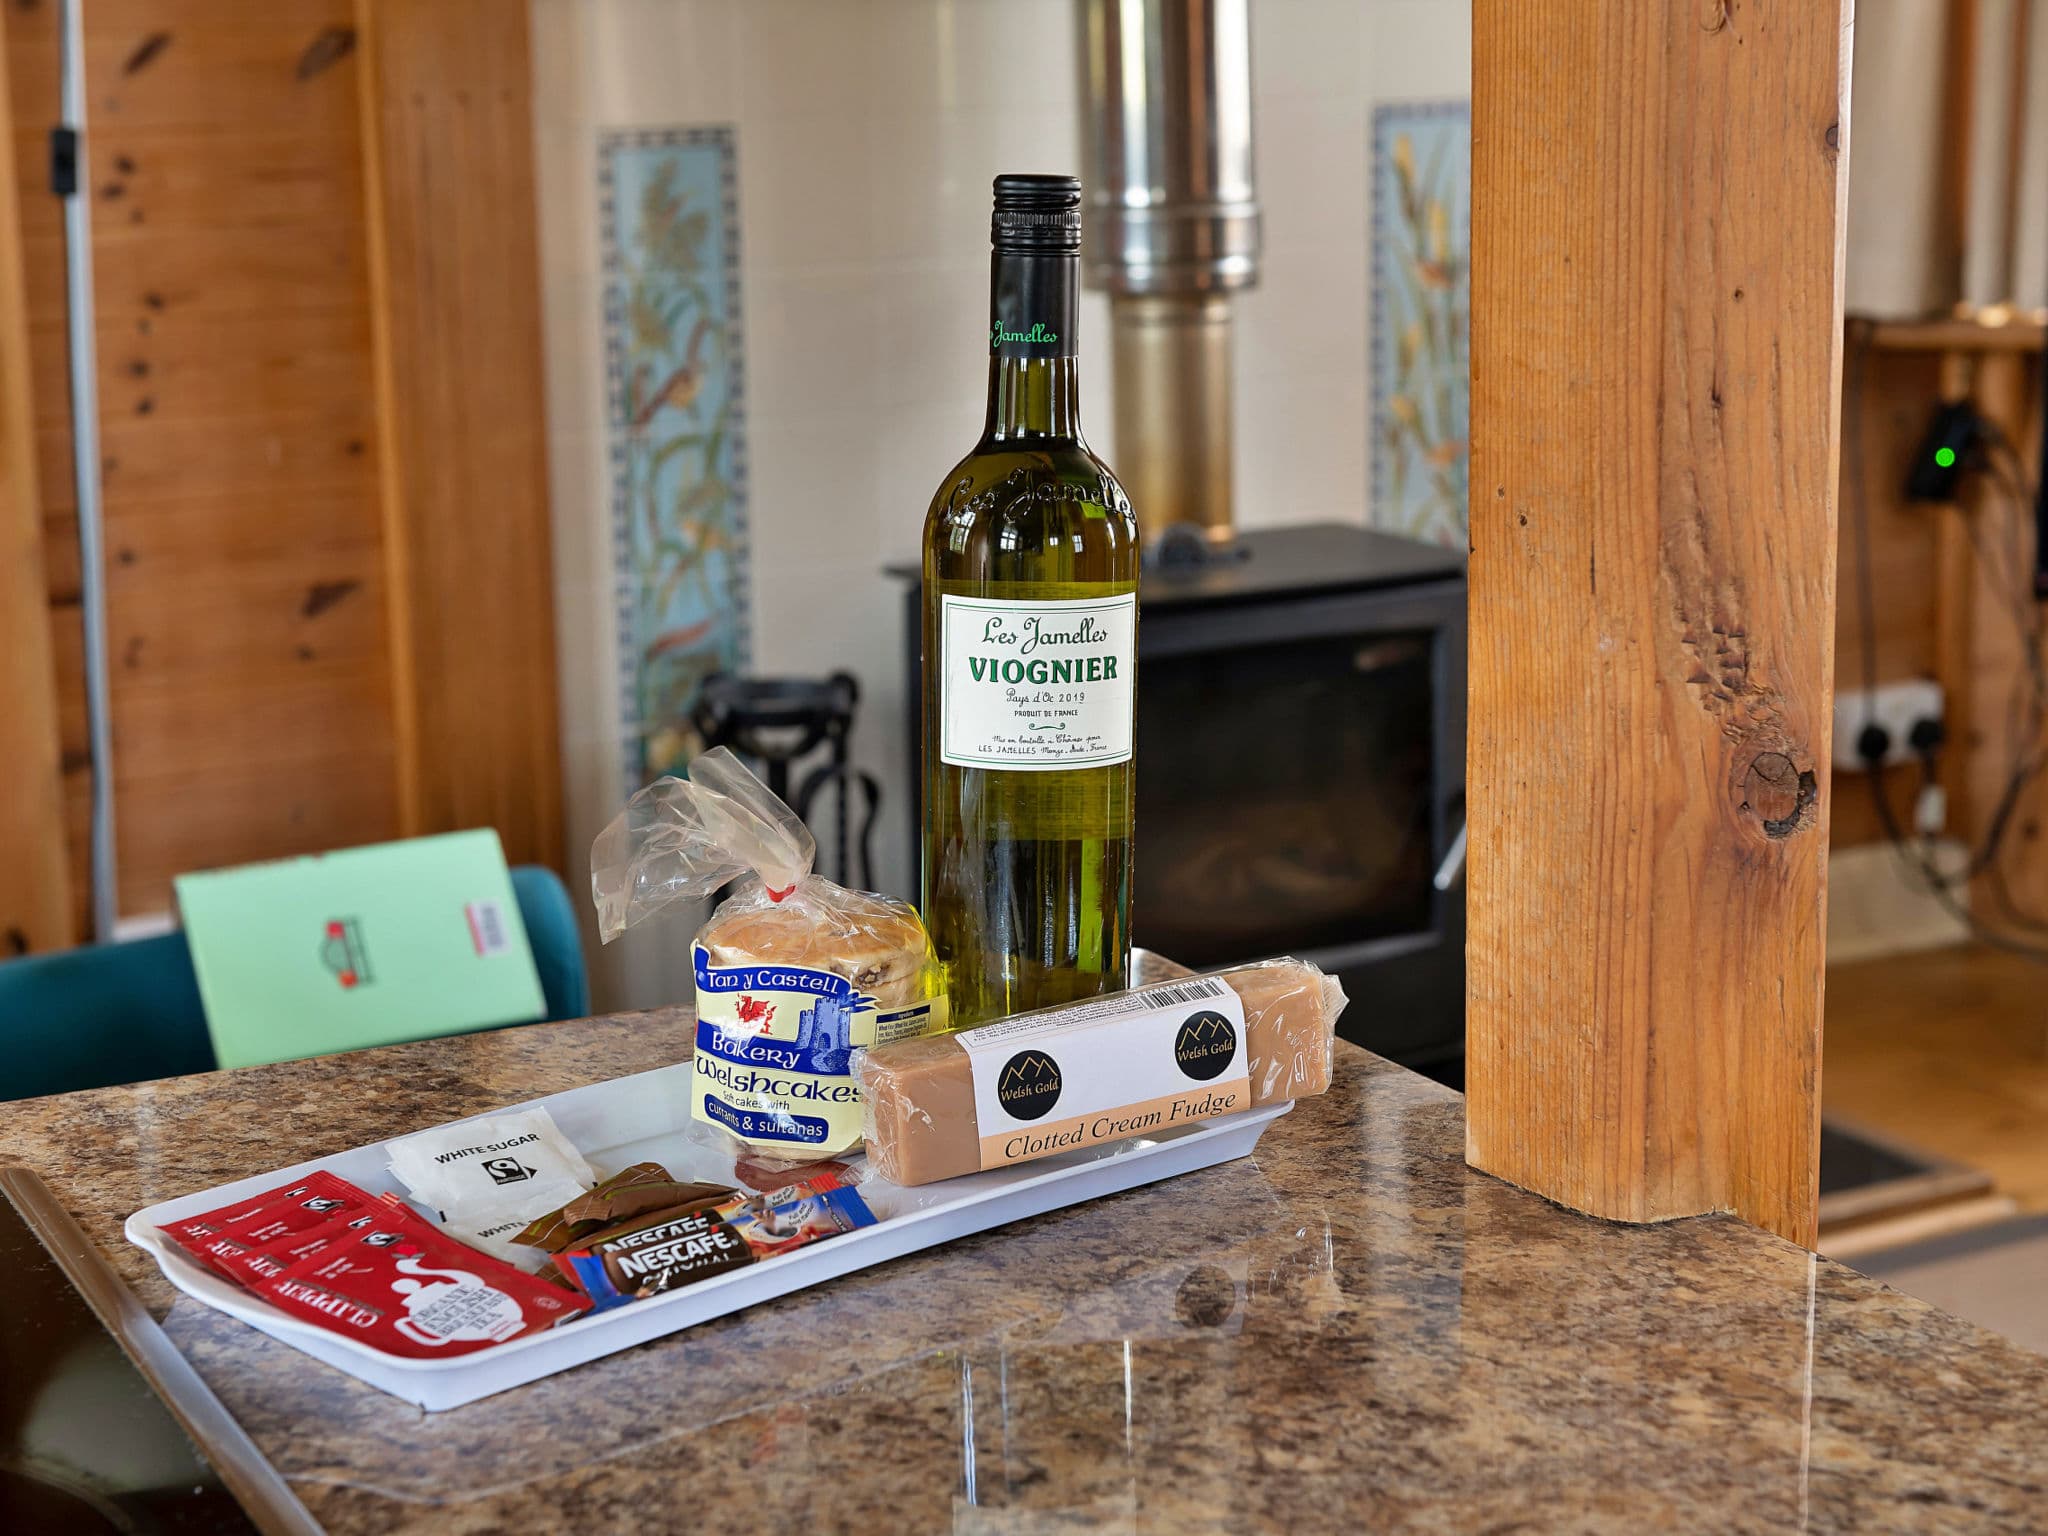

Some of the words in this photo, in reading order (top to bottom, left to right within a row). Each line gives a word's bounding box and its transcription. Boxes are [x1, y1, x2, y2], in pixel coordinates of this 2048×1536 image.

[993, 320, 1058, 347] Jamelles
[982, 616, 1019, 644] Les
[1020, 616, 1108, 655] Jamelles
[968, 655, 1118, 685] VIOGNIER
[1006, 688, 1030, 708] Pays
[1033, 691, 1054, 703] d'Oc
[1058, 691, 1085, 703] 2019
[1014, 710, 1042, 718] PRODUIT
[1054, 709, 1079, 717] FRANCE
[978, 744, 993, 753] LES
[996, 745, 1037, 755] JAMELLES
[707, 972, 739, 988] Tan
[743, 975, 753, 990] y
[757, 970, 839, 995] Castell
[712, 1031, 801, 1069] Bakery
[1177, 1045, 1208, 1063] Welsh
[1210, 1039, 1233, 1055] Gold
[1000, 1083, 1032, 1103] Welsh
[1035, 1078, 1060, 1094] Gold
[708, 1101, 740, 1128] currants
[742, 1115, 754, 1131] &
[758, 1115, 824, 1138] sultanas
[1005, 1122, 1085, 1159] Clotted
[1091, 1110, 1162, 1139] Cream
[1167, 1091, 1237, 1122] Fudge
[434, 1145, 488, 1165] WHITE
[488, 1132, 541, 1153] SUGAR
[277, 1280, 379, 1329] CLIPPER
